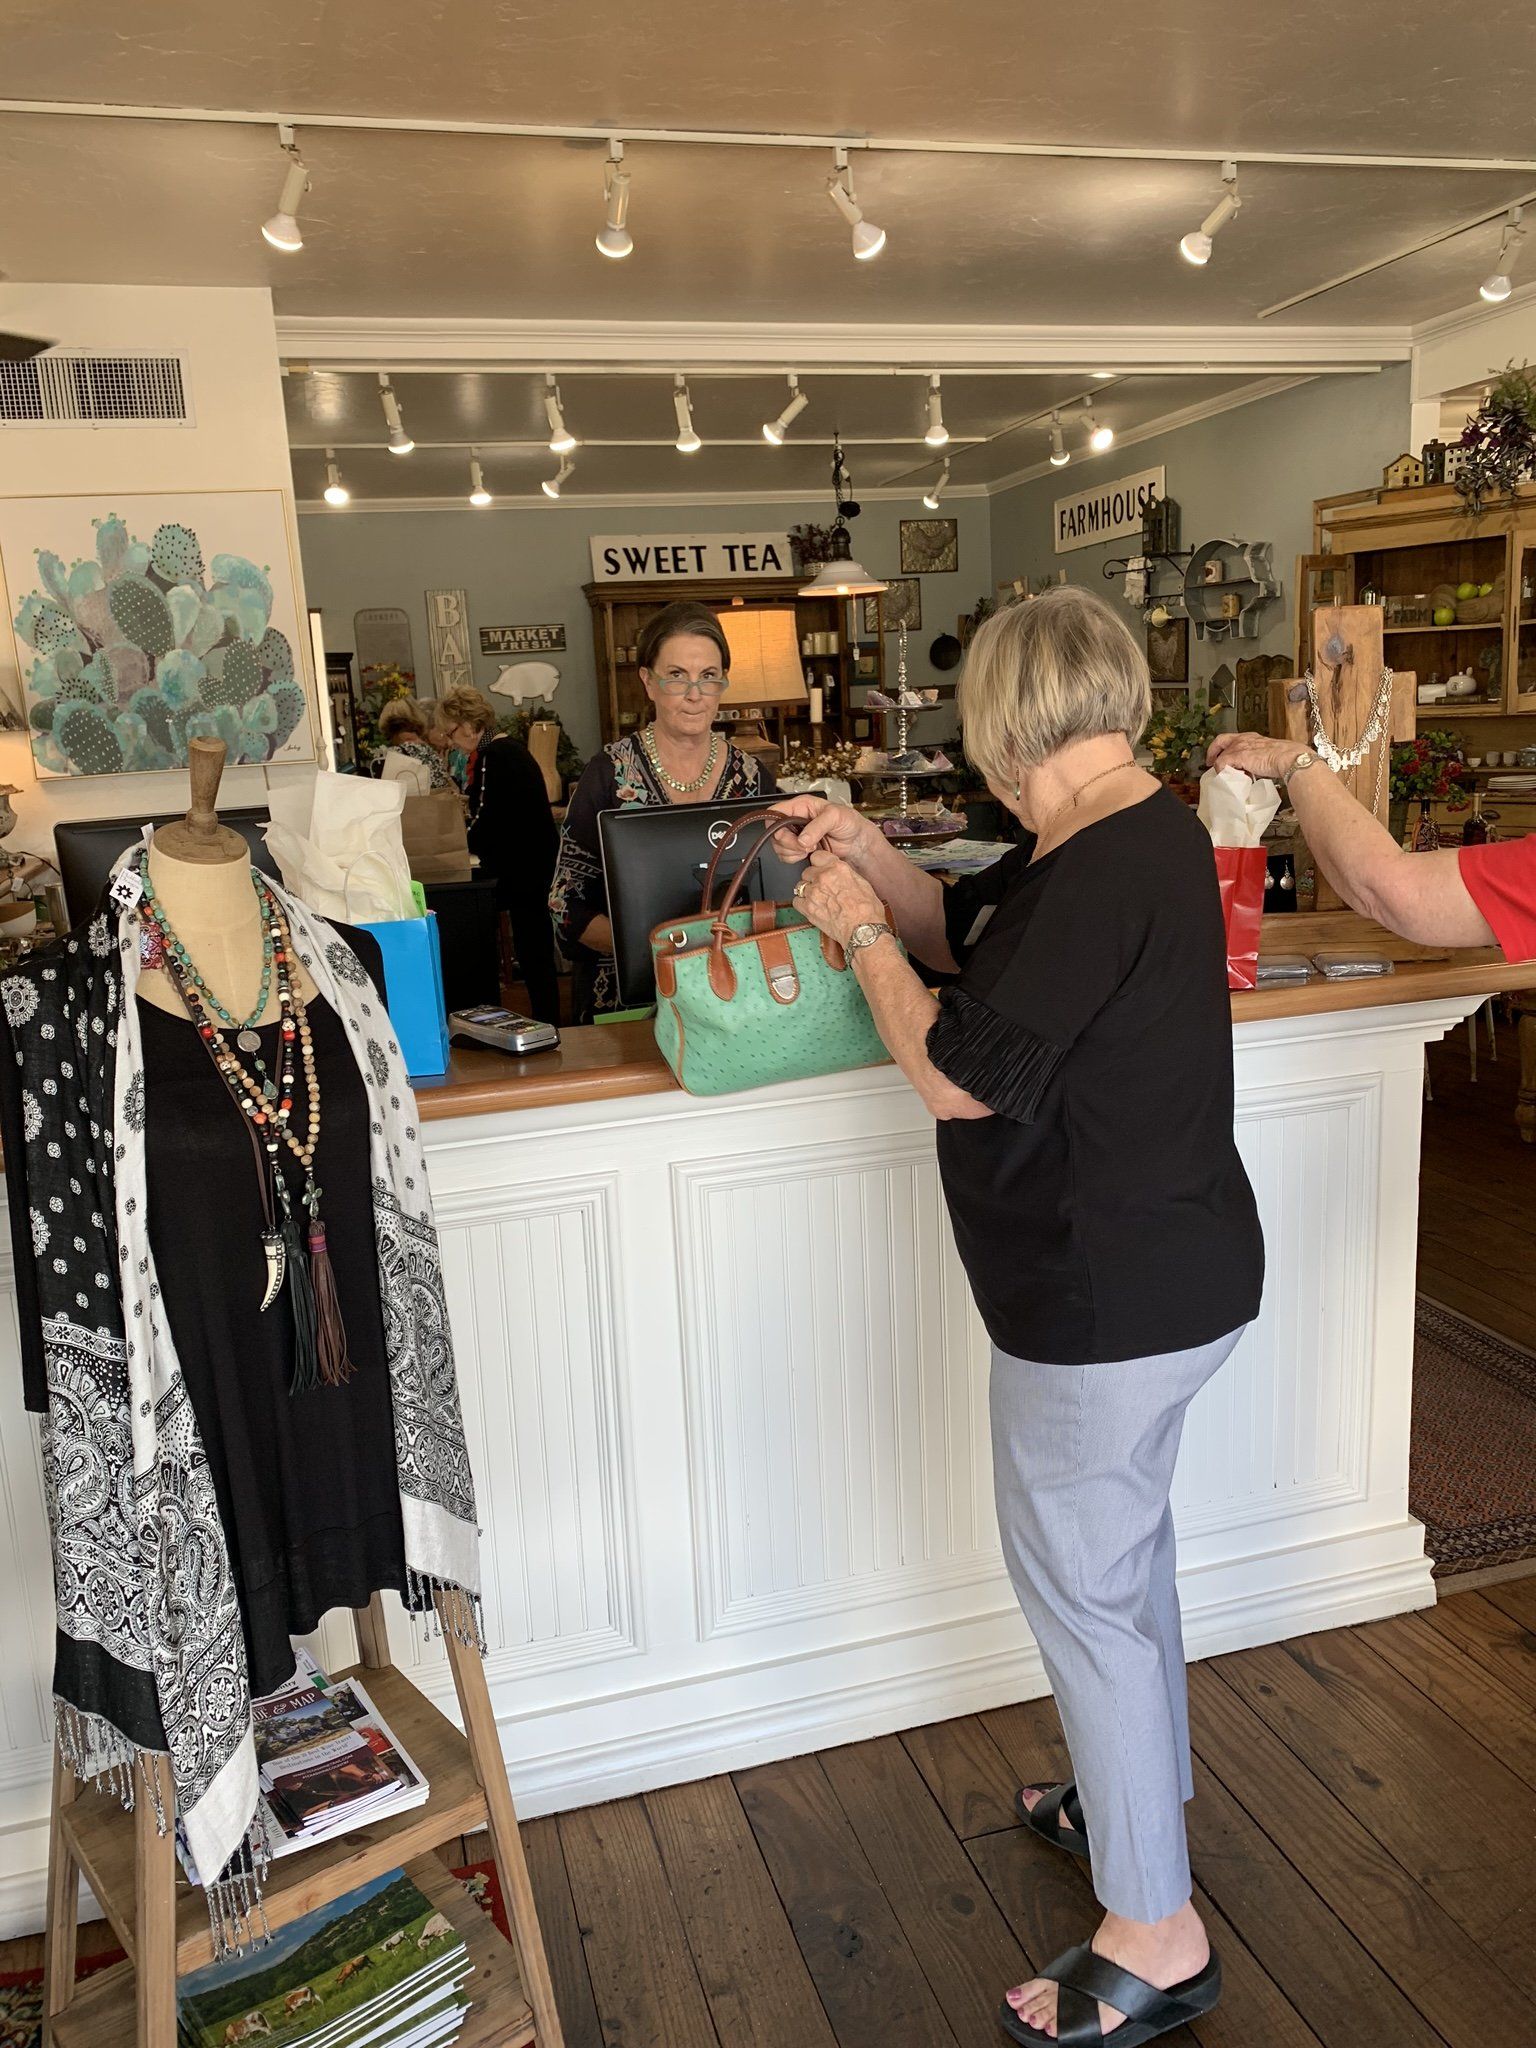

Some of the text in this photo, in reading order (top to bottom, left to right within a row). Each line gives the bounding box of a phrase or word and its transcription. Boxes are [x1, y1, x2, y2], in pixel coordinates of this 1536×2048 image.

[604, 544, 783, 576] SWEET TEA
[435, 595, 468, 694] BAK
[488, 628, 560, 643] MARKET
[500, 641, 552, 650] FRESH
[273, 1703, 287, 1715] &
[289, 1692, 316, 1709] MAP
